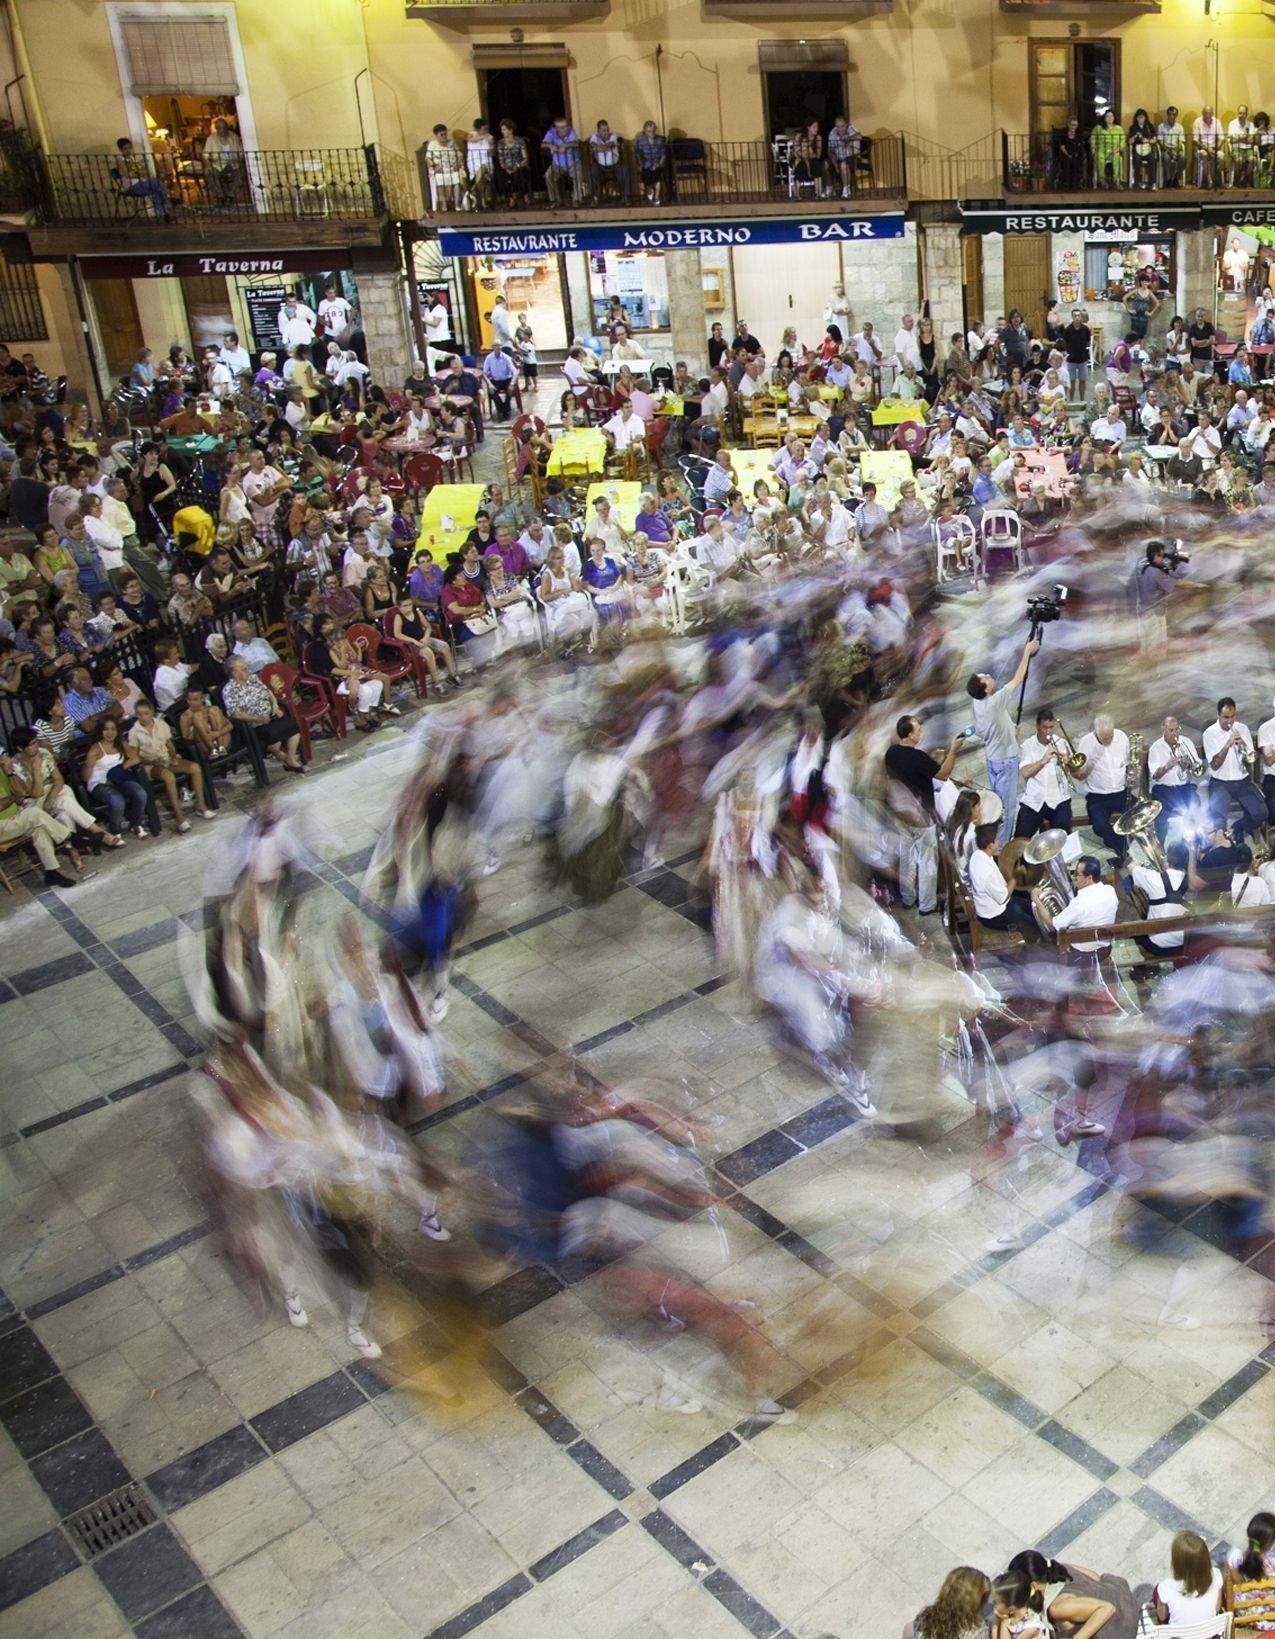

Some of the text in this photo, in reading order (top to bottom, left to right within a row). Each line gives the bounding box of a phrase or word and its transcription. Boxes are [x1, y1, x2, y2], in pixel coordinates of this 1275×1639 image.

[1006, 215, 1159, 230] RESTAURANTE
[472, 221, 876, 252] RESTAURANTE MODERNO BAR
[146, 258, 284, 275] La Taverna
